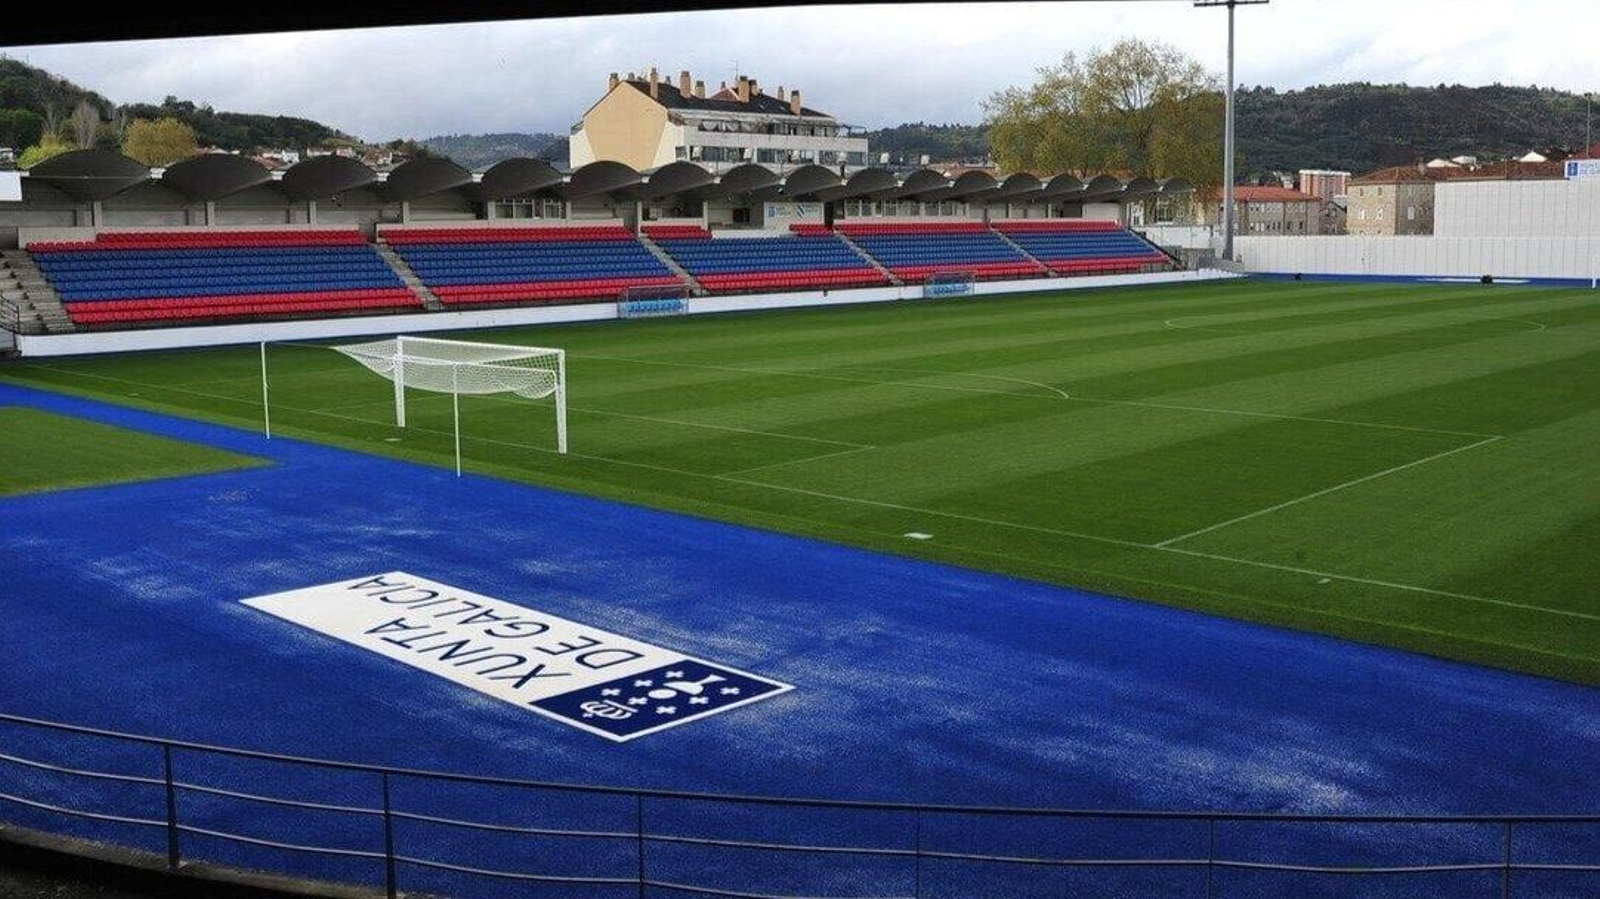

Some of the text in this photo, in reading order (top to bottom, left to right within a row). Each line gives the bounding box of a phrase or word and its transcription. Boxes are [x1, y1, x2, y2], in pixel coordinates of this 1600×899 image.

[348, 576, 645, 670] DE GALICIA
[365, 617, 571, 690] XUNTA
